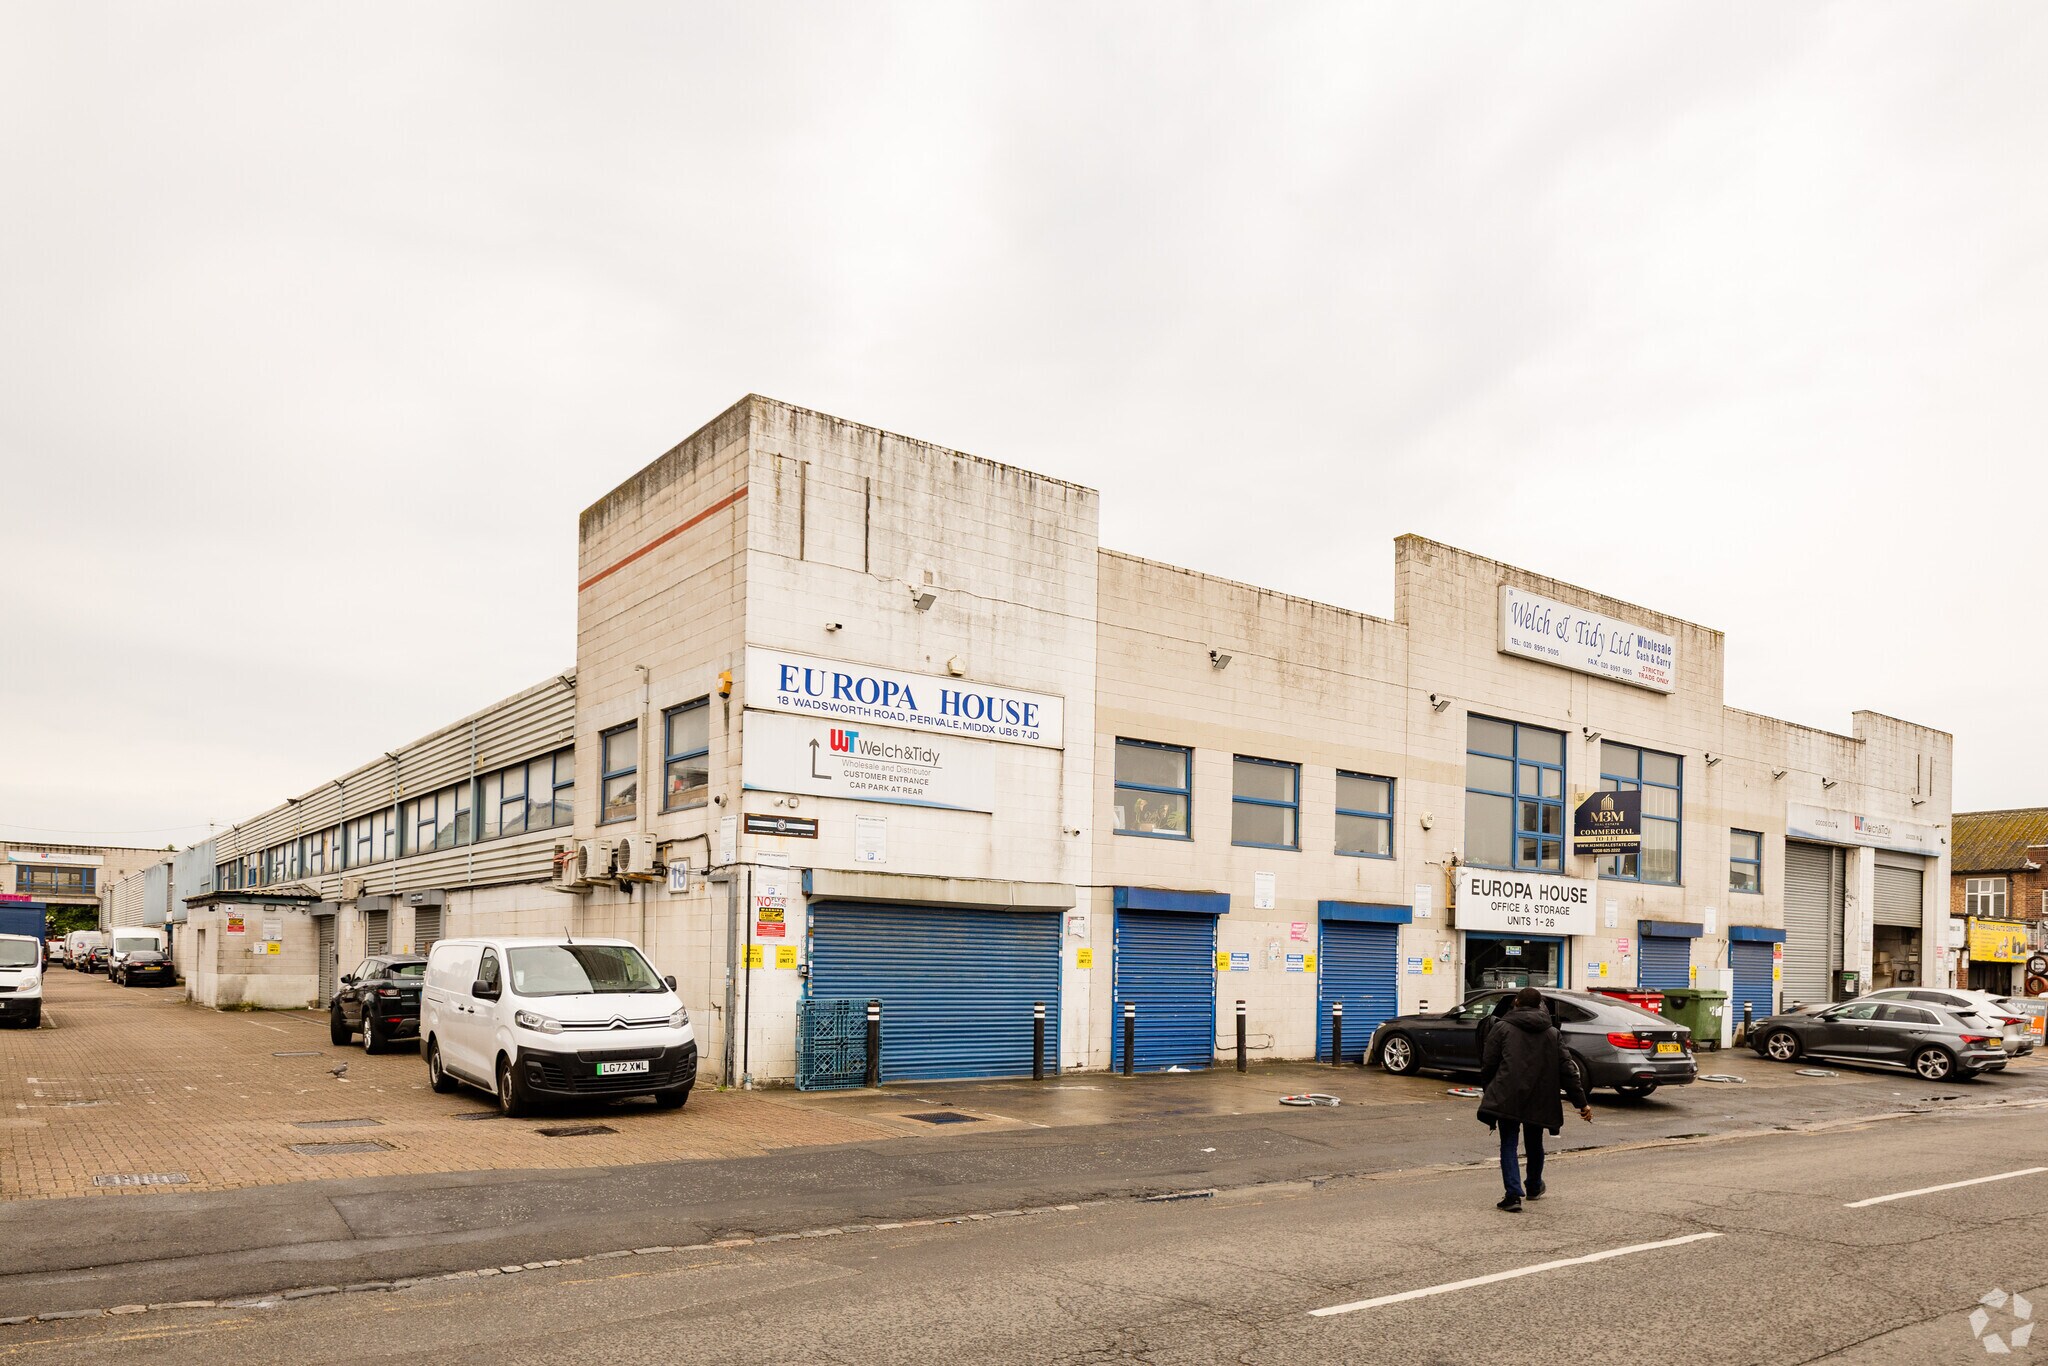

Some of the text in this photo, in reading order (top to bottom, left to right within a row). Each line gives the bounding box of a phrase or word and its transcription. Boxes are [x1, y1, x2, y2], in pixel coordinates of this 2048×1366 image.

[1511, 602, 1634, 658] Welch & Tidy Ltd
[1511, 637, 1521, 646] TEL:
[1523, 641, 1532, 649] 020
[1637, 634, 1672, 656] Wholesale
[1588, 658, 1599, 667] FAX:
[1600, 661, 1609, 670] 020
[1636, 650, 1672, 669] Cash & Carry
[1642, 665, 1665, 676] STRICTLY
[1638, 672, 1670, 685] TRADE ONLY
[778, 663, 1040, 728] EUROPA HOUSE
[777, 695, 789, 706] 18
[793, 697, 871, 717] WADSWORTH
[963, 722, 996, 735] MIDDX
[998, 726, 1019, 738] UB6
[1021, 729, 1040, 740] 7JD
[842, 759, 931, 776] Wholesale and Distributor
[843, 770, 929, 786] CUSTOMER ENTRANCE
[849, 781, 866, 790] CAR
[868, 783, 889, 792] PARK
[1590, 810, 1624, 822] M3M
[1580, 828, 1634, 836] COMMERCIAL
[671, 863, 686, 888] 18
[1471, 878, 1588, 904] EUROPA HOUSE
[757, 896, 771, 906] NO
[1490, 901, 1570, 916] OFFICE & STORAGE
[1507, 916, 1532, 926] UNITS
[603, 1061, 647, 1073] LG72 XWL
